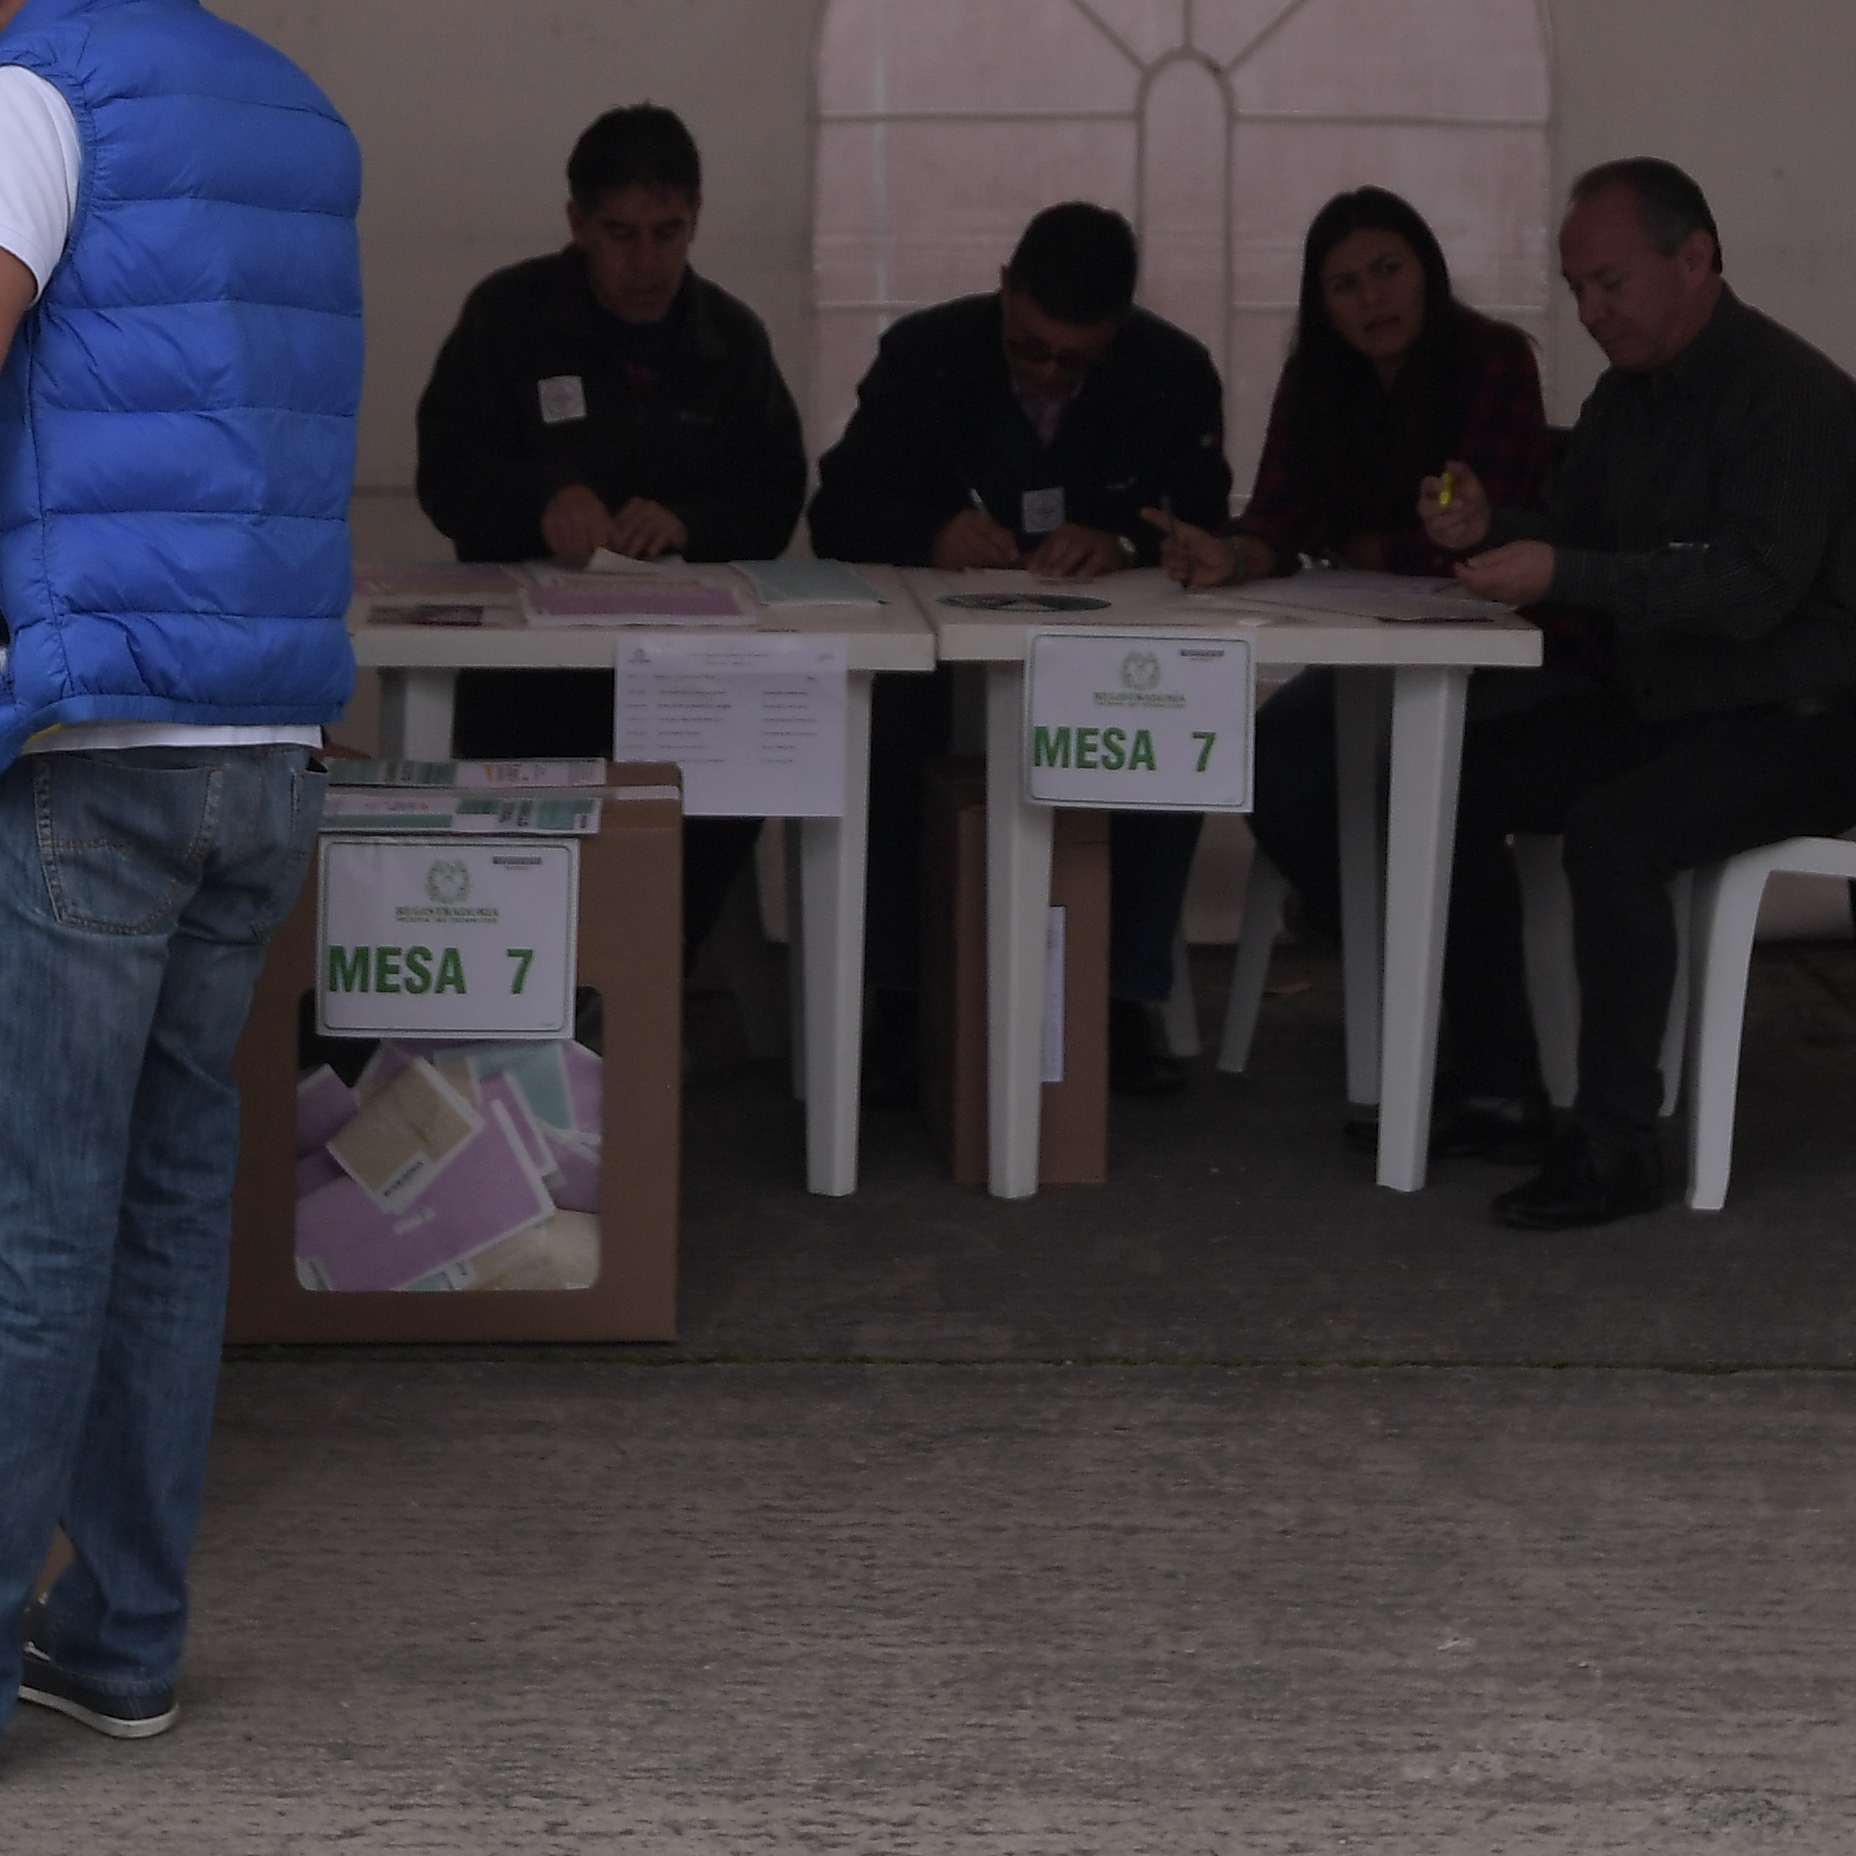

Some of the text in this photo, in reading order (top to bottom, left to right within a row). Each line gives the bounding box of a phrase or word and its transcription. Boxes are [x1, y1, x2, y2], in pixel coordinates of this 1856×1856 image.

[1033, 725, 1216, 773] MESA 7
[327, 945, 534, 995] MESA 7
